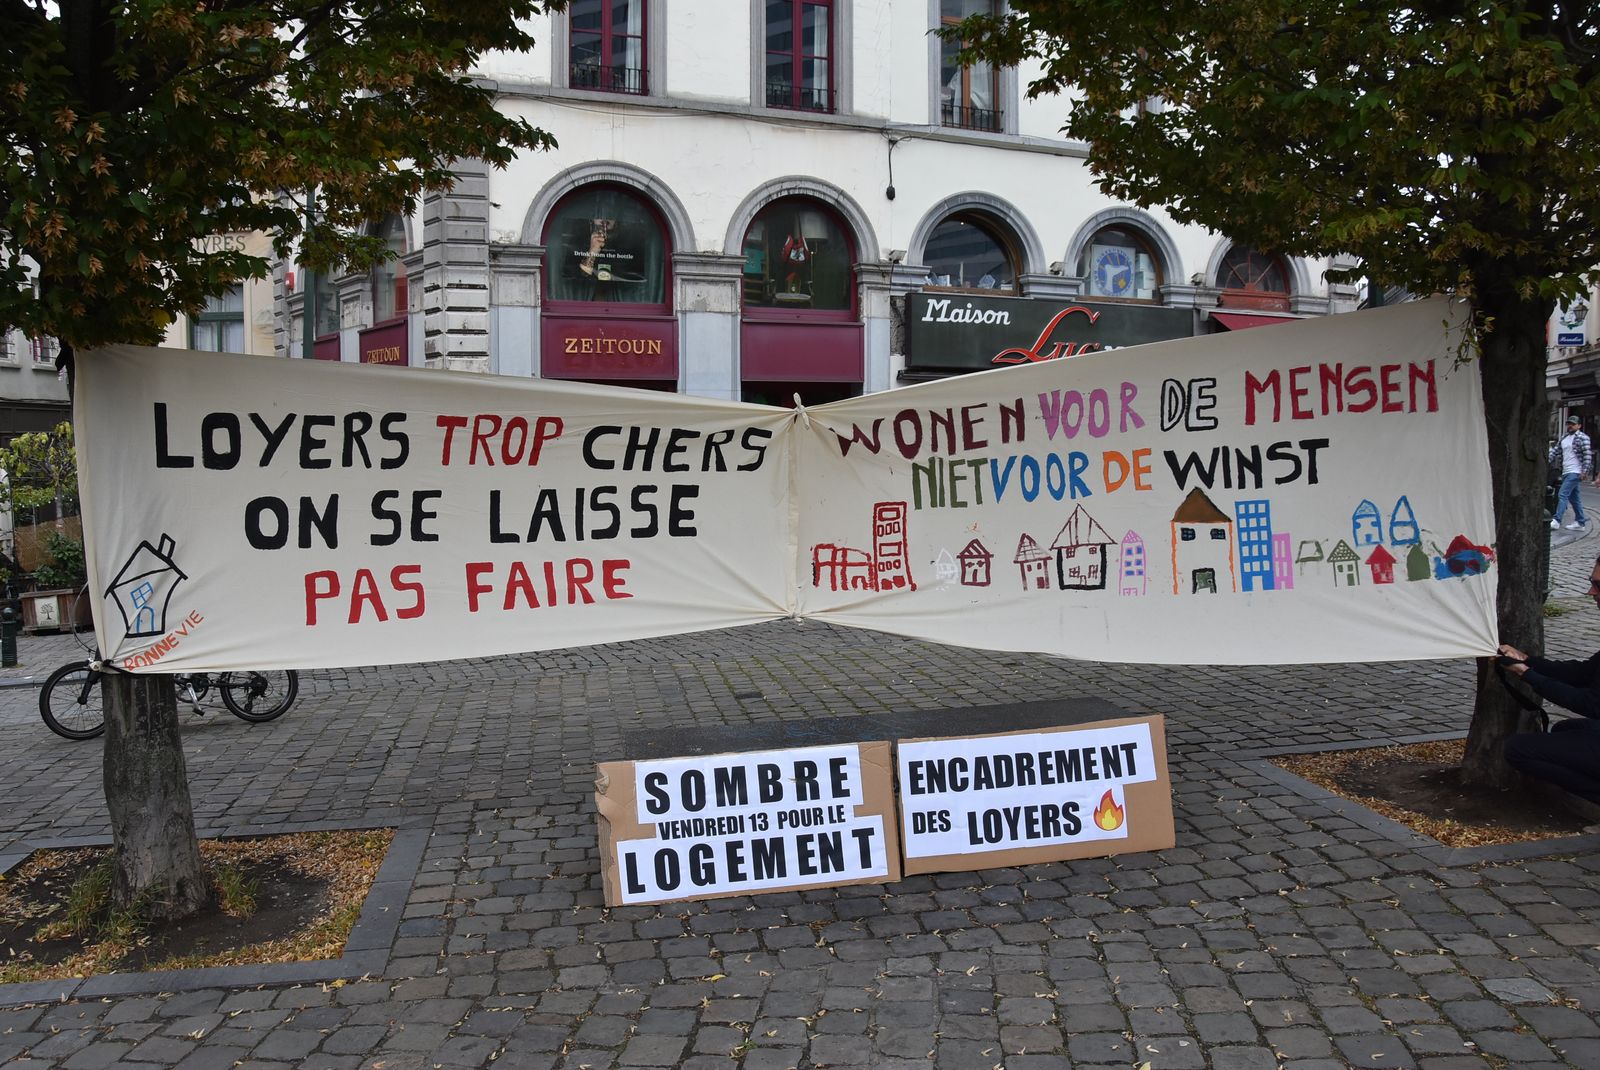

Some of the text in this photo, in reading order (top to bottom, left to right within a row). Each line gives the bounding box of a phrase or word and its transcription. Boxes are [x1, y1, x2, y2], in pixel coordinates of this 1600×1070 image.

[921, 298, 1011, 325] Maison
[366, 346, 401, 364] ZEITOUN
[563, 337, 662, 355] ZEITOUN
[154, 402, 773, 473] LOYERS TROP CHERS
[827, 359, 1440, 460] WONEN VOOR DE MENSEN
[989, 450, 1093, 504] VOOR
[1102, 447, 1153, 494] DE
[1163, 437, 1330, 491] WINST
[244, 484, 700, 551] ON SE LAISSE
[304, 557, 634, 627] PAS FAIRE
[643, 757, 851, 815] SOMBRE
[908, 742, 1138, 795] ENCADREMENT
[658, 804, 846, 841] VENDREDI 13 POUR LE
[912, 801, 1082, 846] DES LOYERS
[624, 827, 875, 894] LOGEMENT
